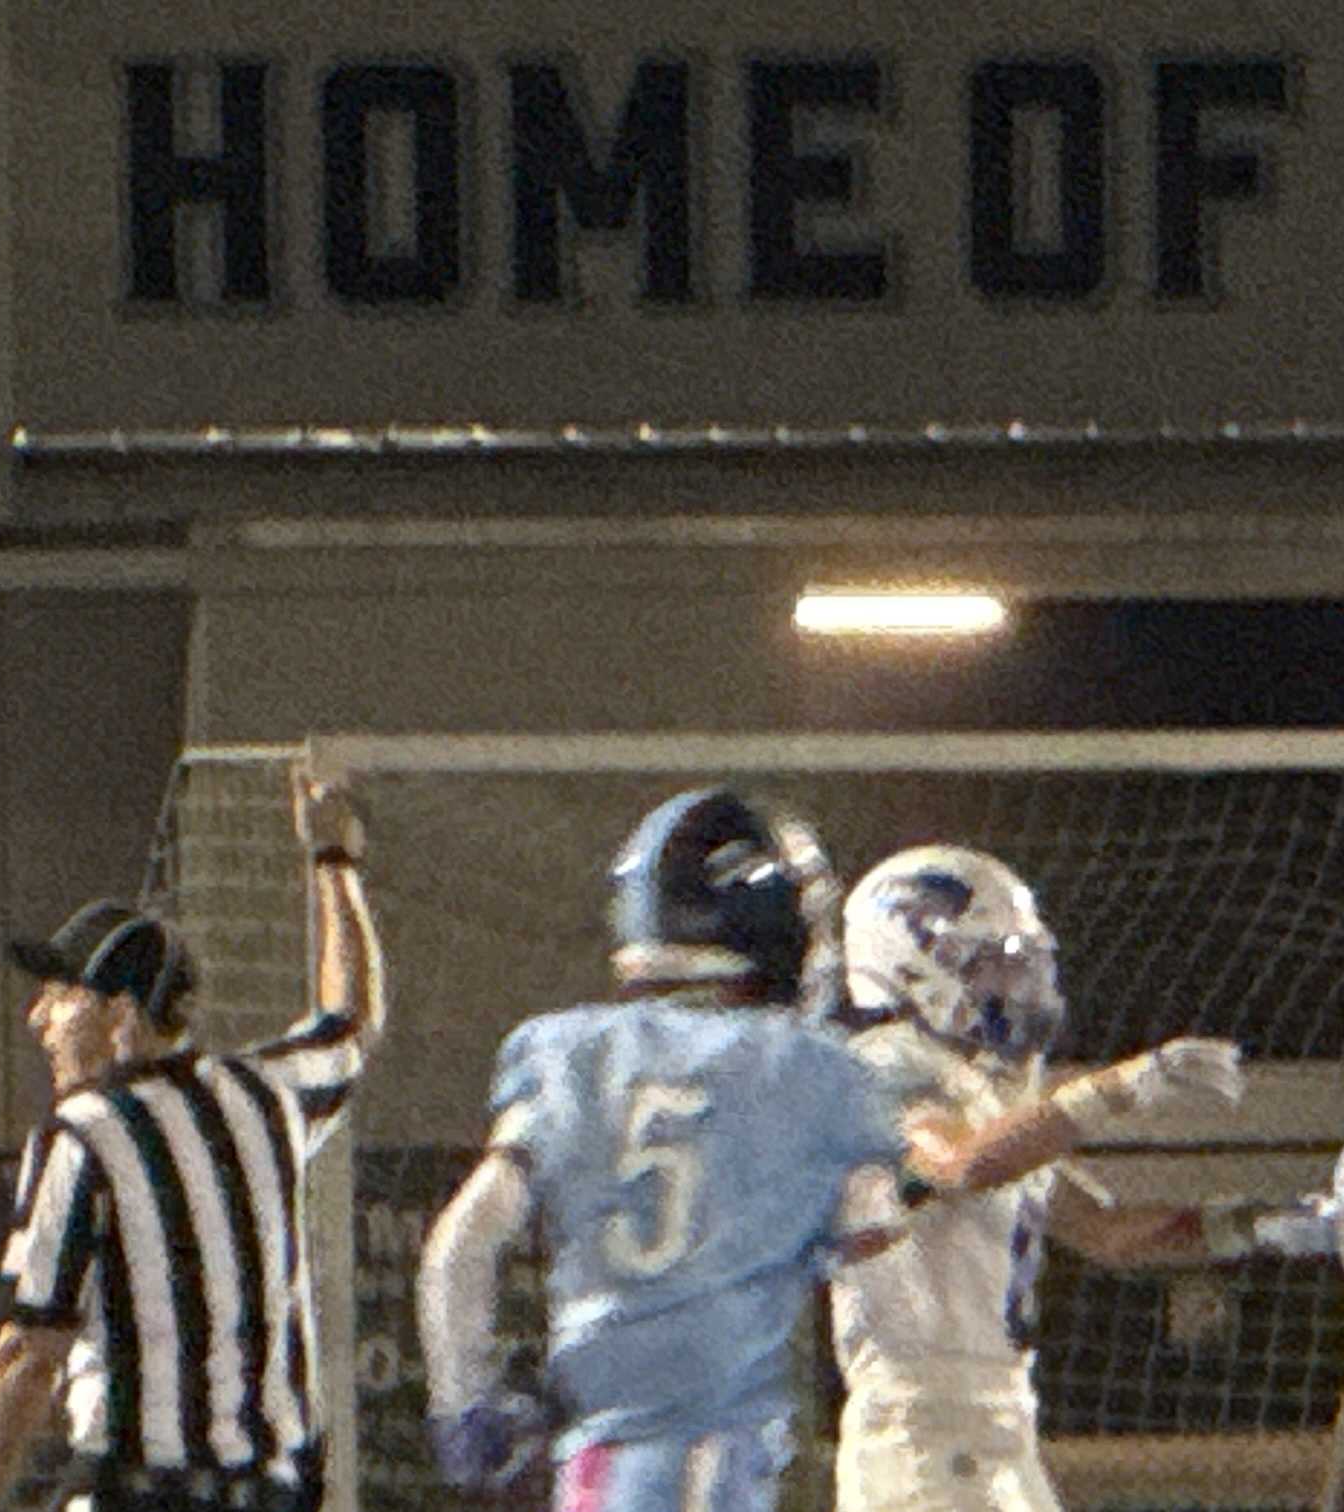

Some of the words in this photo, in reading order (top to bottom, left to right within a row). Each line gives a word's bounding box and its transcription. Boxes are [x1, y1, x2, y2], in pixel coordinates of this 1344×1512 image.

[120, 60, 890, 303] HOME
[967, 57, 1294, 302] OF
[602, 1080, 709, 1276] 5
